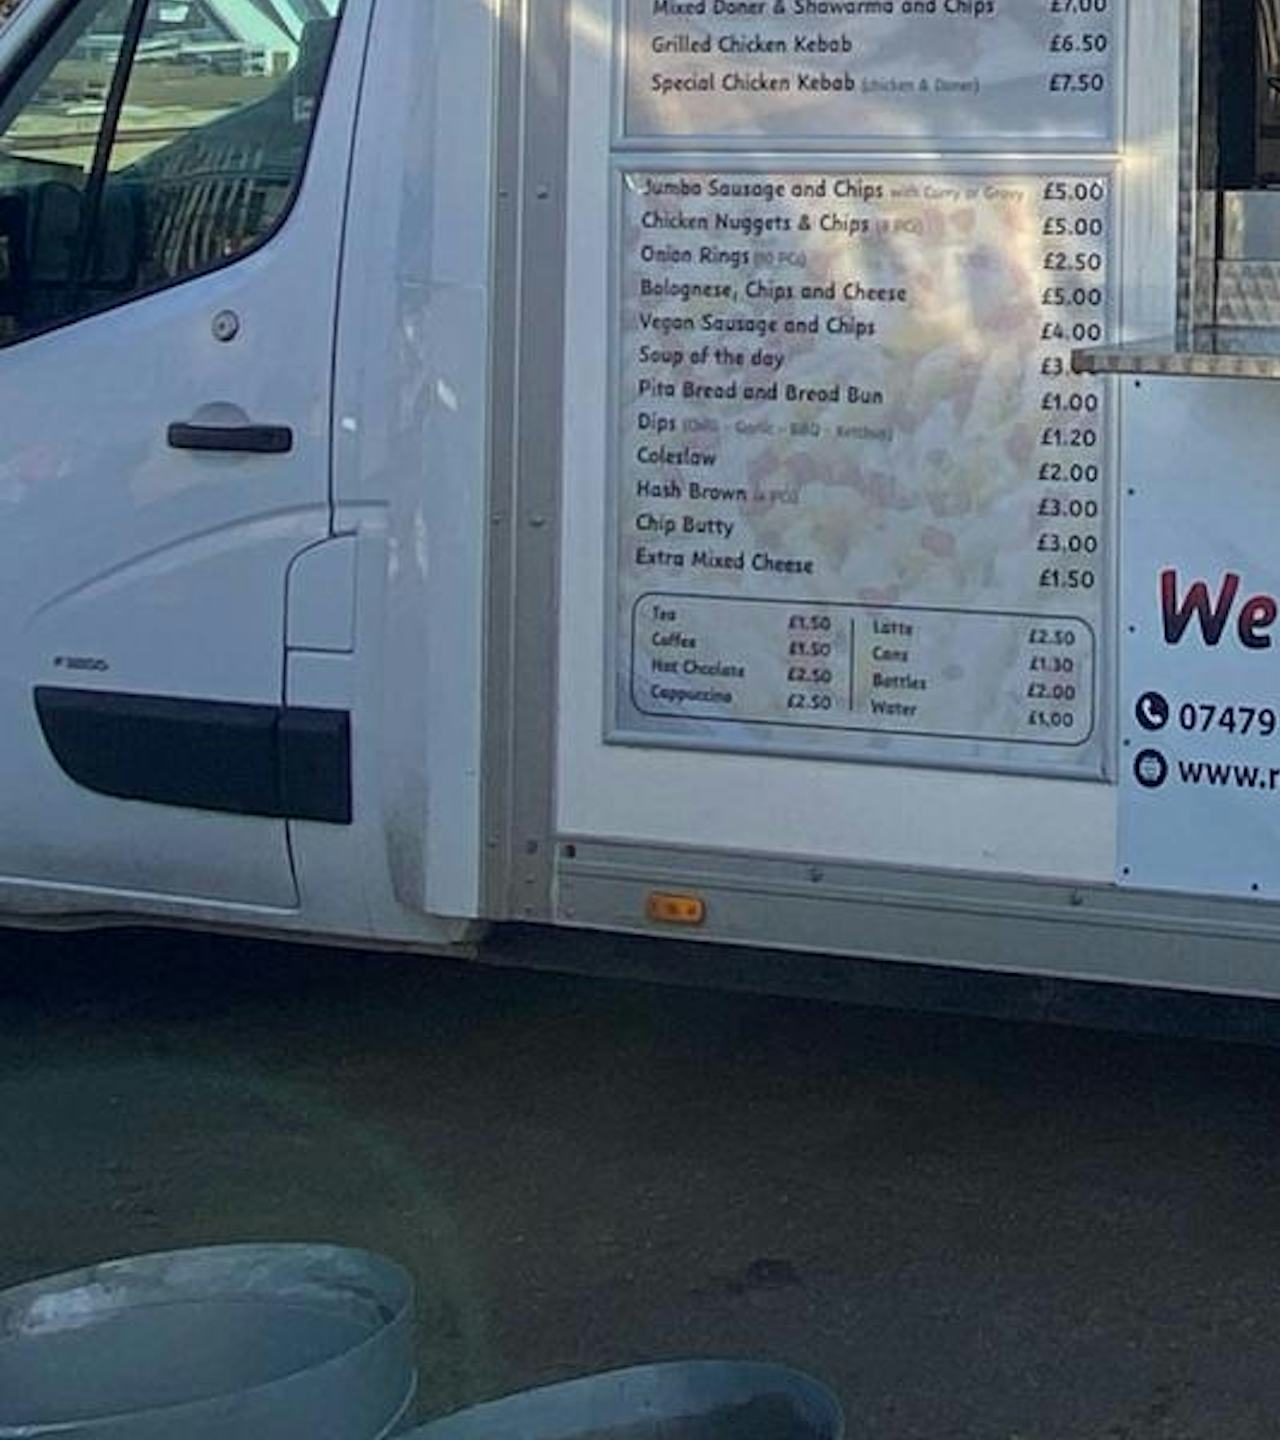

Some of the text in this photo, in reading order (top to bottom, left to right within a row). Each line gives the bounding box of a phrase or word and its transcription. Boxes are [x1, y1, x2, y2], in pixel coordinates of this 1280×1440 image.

[652, 35, 852, 54] Grilled Chicken Kebab
[1049, 34, 1107, 52] £6.50
[640, 315, 875, 337] Vegan Sausage and Chips
[1041, 323, 1101, 341] £4.00
[639, 382, 883, 404] Pita Bread and Bread Bun
[1041, 394, 1098, 412] £1.00
[635, 548, 814, 574] Extra Mixed Cheese
[1040, 571, 1095, 588] £1.50
[1158, 569, 1279, 649] We
[1178, 703, 1275, 736] 07479
